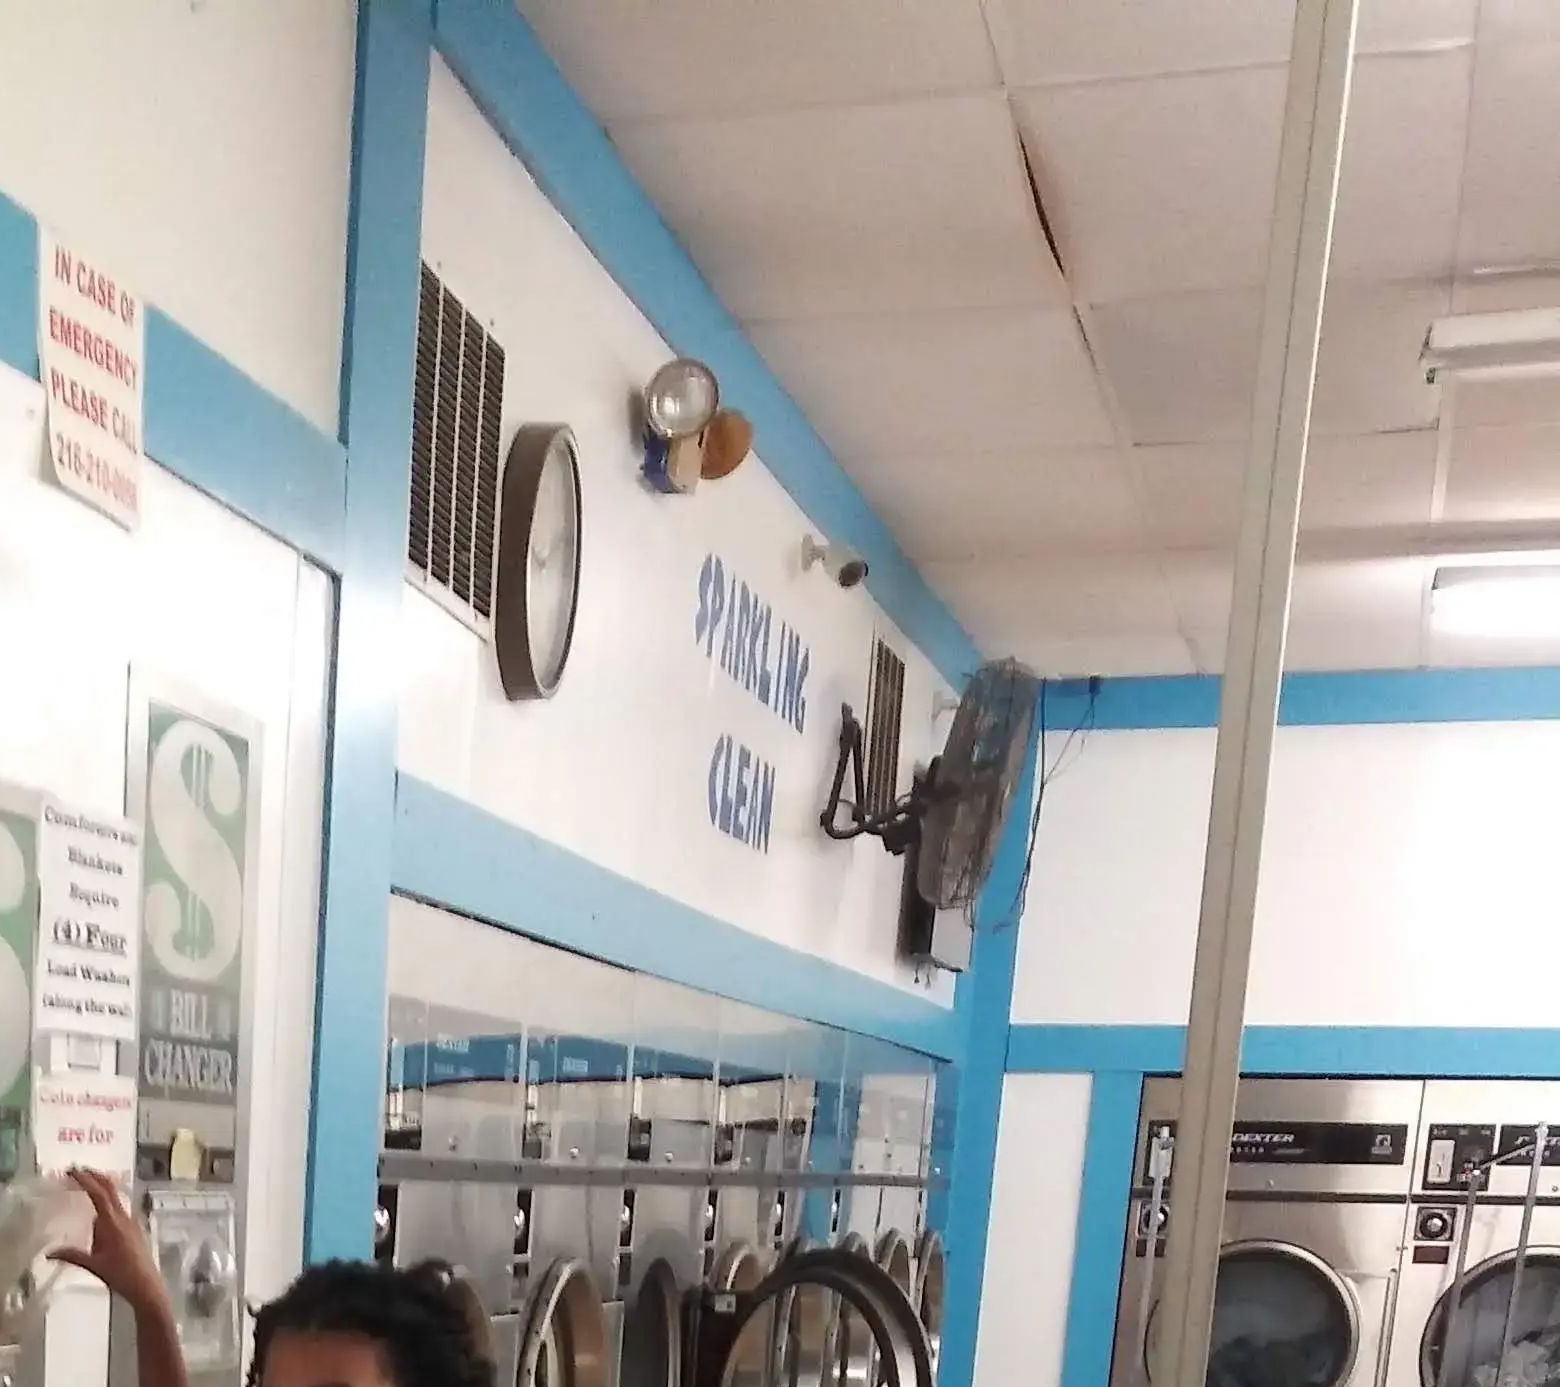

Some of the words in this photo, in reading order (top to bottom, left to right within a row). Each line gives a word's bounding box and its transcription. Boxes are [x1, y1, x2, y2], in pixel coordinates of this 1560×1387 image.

[53, 245, 71, 285] IN
[75, 260, 116, 315] CASE
[120, 289, 135, 327] OF
[48, 304, 137, 391] EMERGENCY
[50, 367, 108, 431] PLEASE
[112, 405, 138, 455] CALL
[694, 552, 810, 735] SPARKLING
[707, 732, 775, 855] CLEAN
[67, 845, 123, 876] Blankets
[69, 881, 119, 909] Require
[52, 917, 81, 942] (4)
[85, 920, 127, 951] Four
[47, 958, 77, 977] Load
[84, 996, 104, 1013] the
[169, 988, 212, 1040] BILL
[144, 1038, 233, 1096] CHANGER
[57, 1126, 85, 1142] are
[88, 1121, 114, 1143] for
[1232, 1132, 1296, 1144] DEXTER
